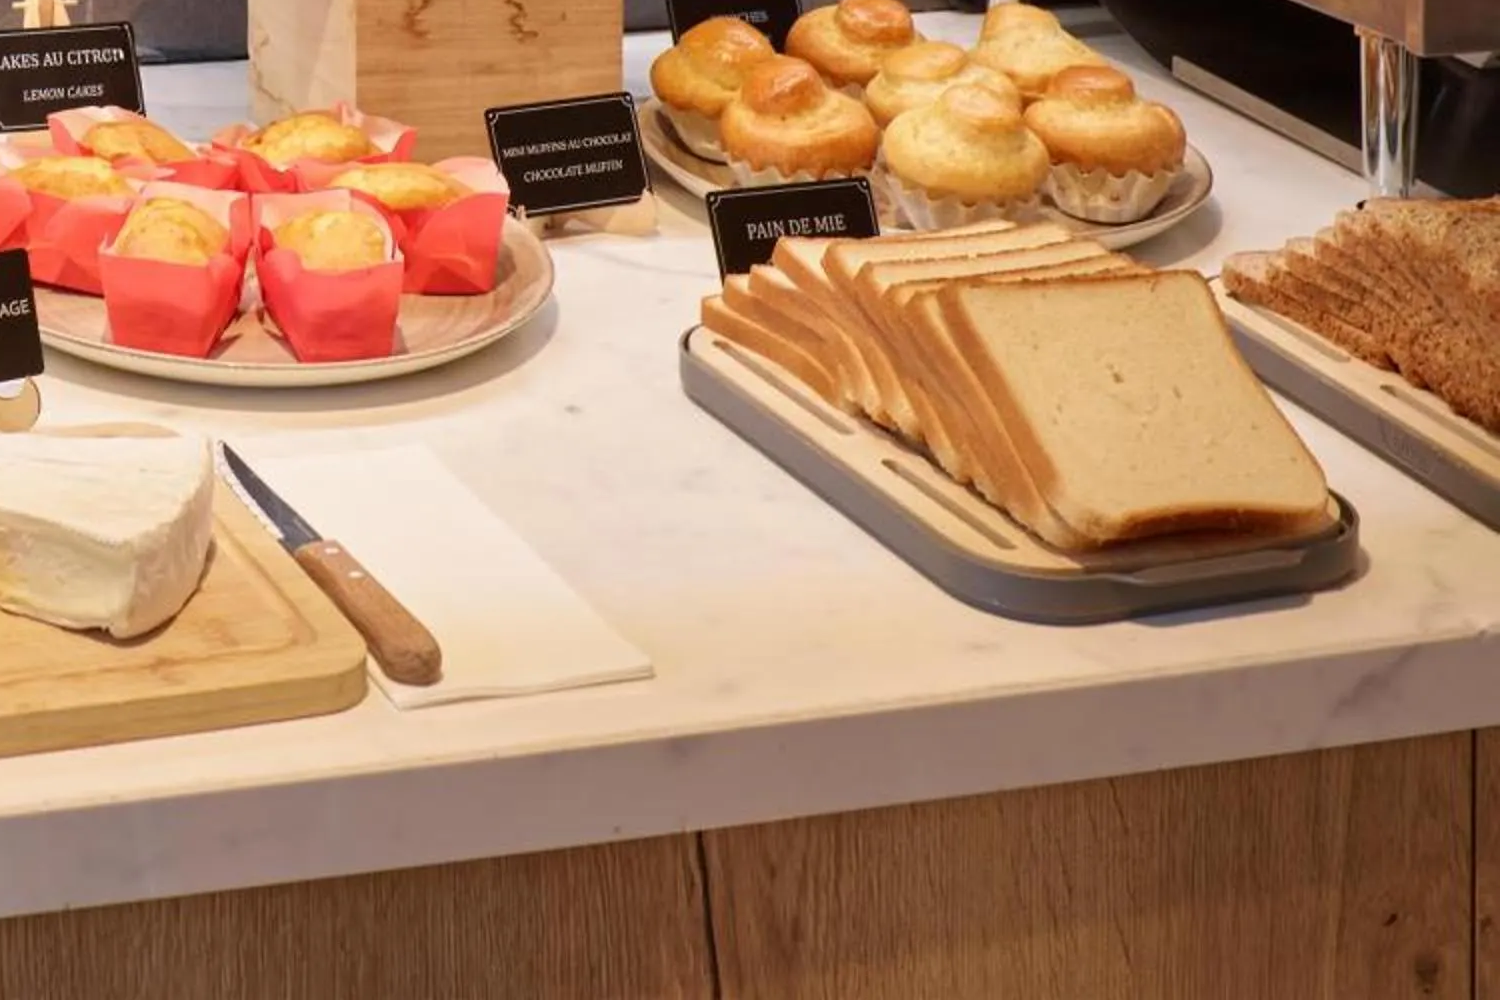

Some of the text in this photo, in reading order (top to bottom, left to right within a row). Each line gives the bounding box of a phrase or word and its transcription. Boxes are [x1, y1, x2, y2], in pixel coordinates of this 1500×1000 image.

[43, 51, 63, 67] AU
[23, 83, 104, 101] LEMON CAKES
[581, 132, 632, 147] CHOCOLAT
[523, 160, 624, 183] CHOCOLATE MUFFIN
[747, 213, 847, 240] PAIN DE MIE
